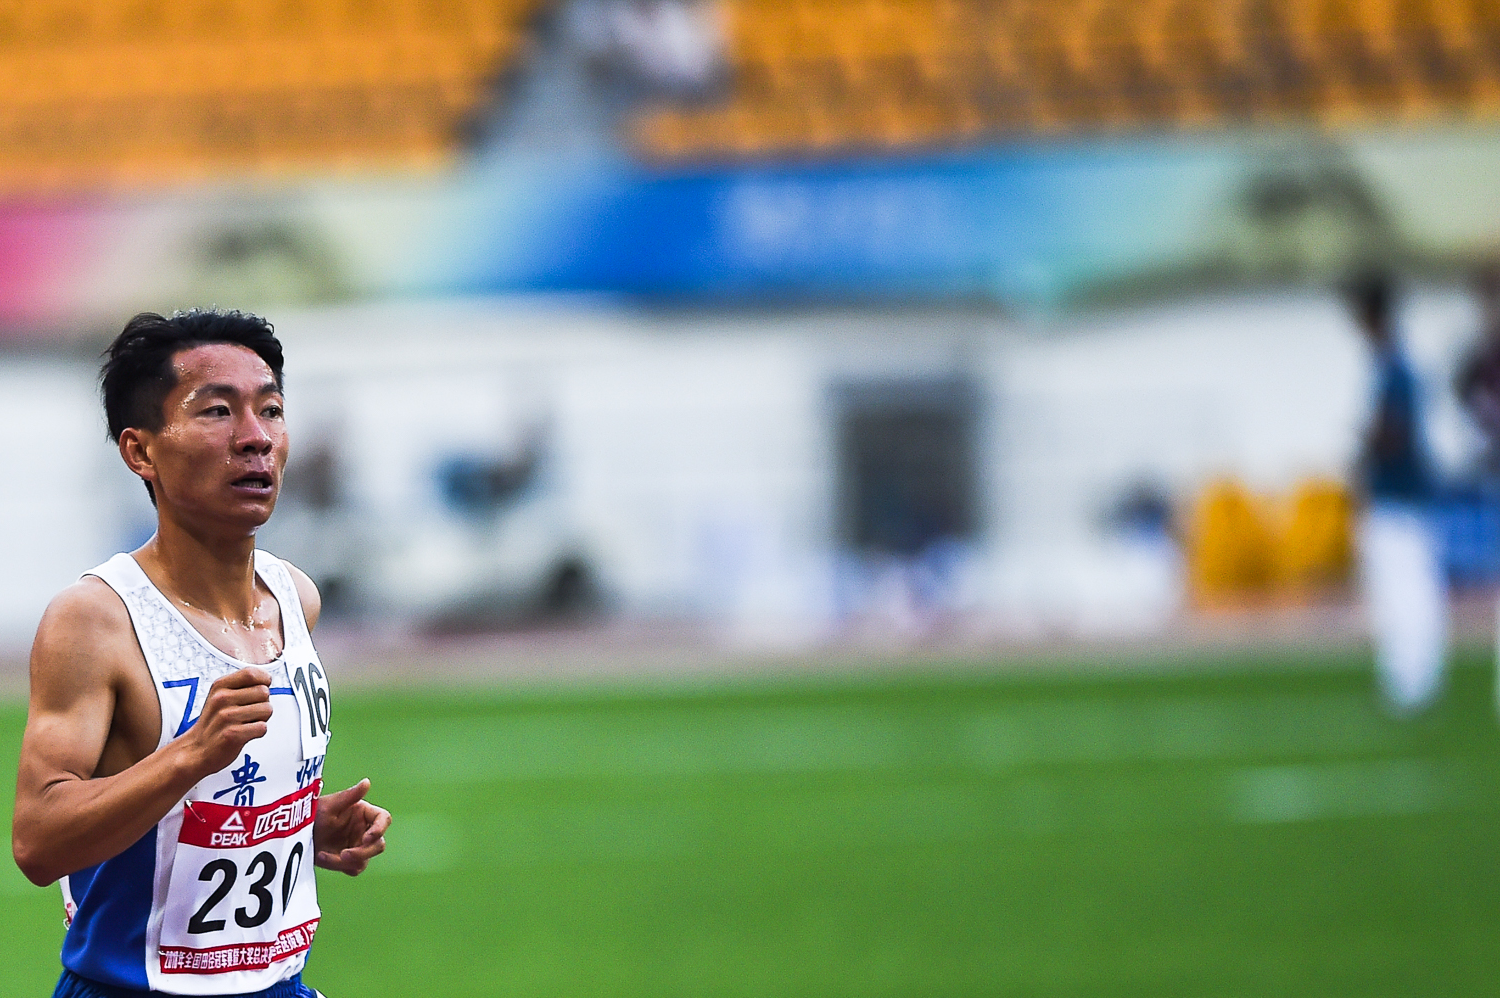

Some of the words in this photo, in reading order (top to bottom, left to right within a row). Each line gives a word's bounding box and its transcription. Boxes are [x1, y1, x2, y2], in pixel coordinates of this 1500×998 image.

[294, 662, 329, 738] 16
[210, 831, 251, 846] PEAK
[252, 791, 313, 840] 匹克体育
